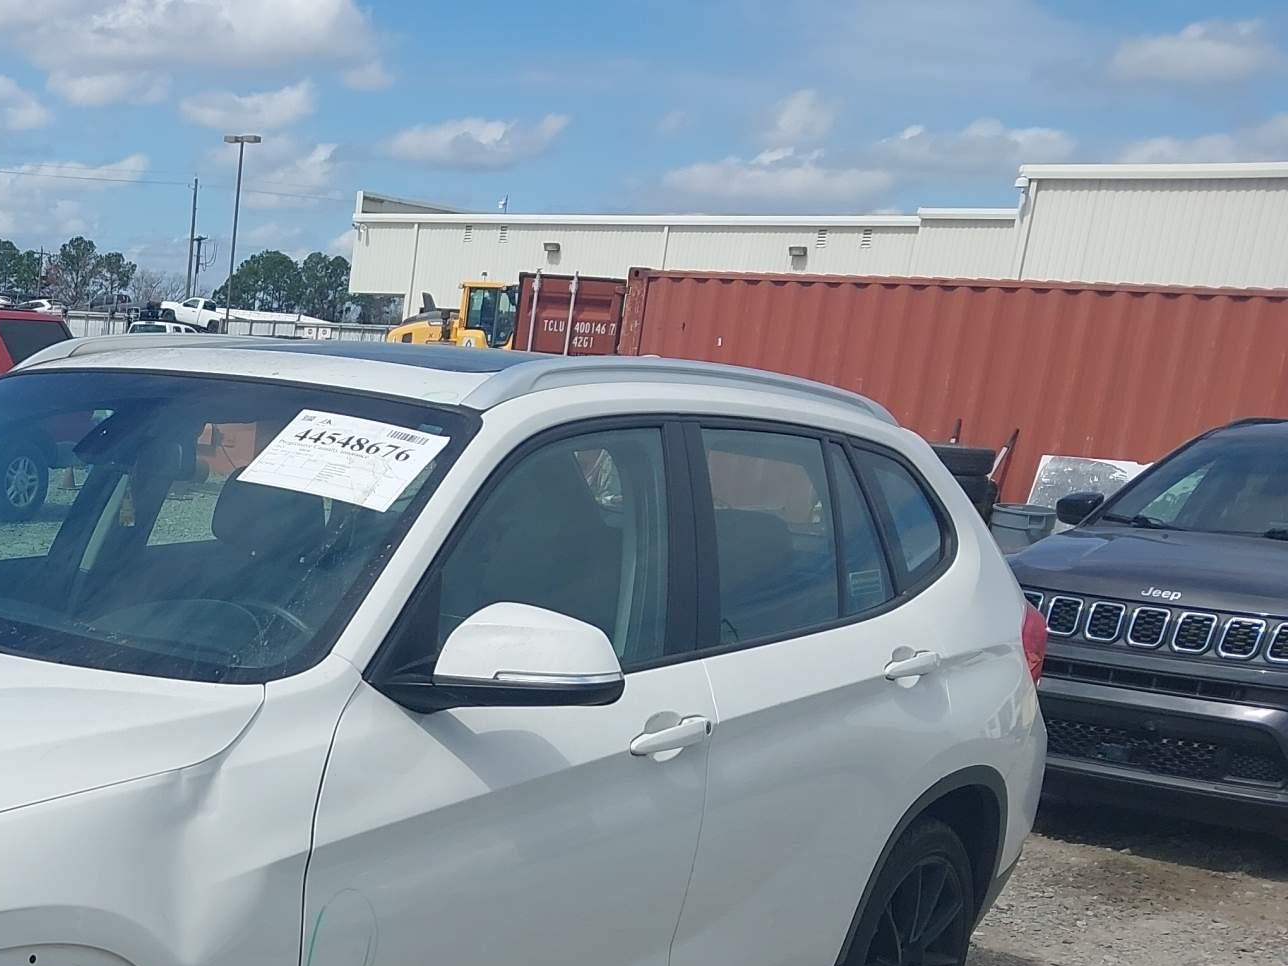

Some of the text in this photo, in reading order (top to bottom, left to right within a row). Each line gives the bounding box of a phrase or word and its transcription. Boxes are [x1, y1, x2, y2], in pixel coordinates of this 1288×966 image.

[543, 319, 616, 336] TCLU 400146 7
[295, 428, 416, 461] 44548676
[1141, 586, 1182, 601] Jeep
